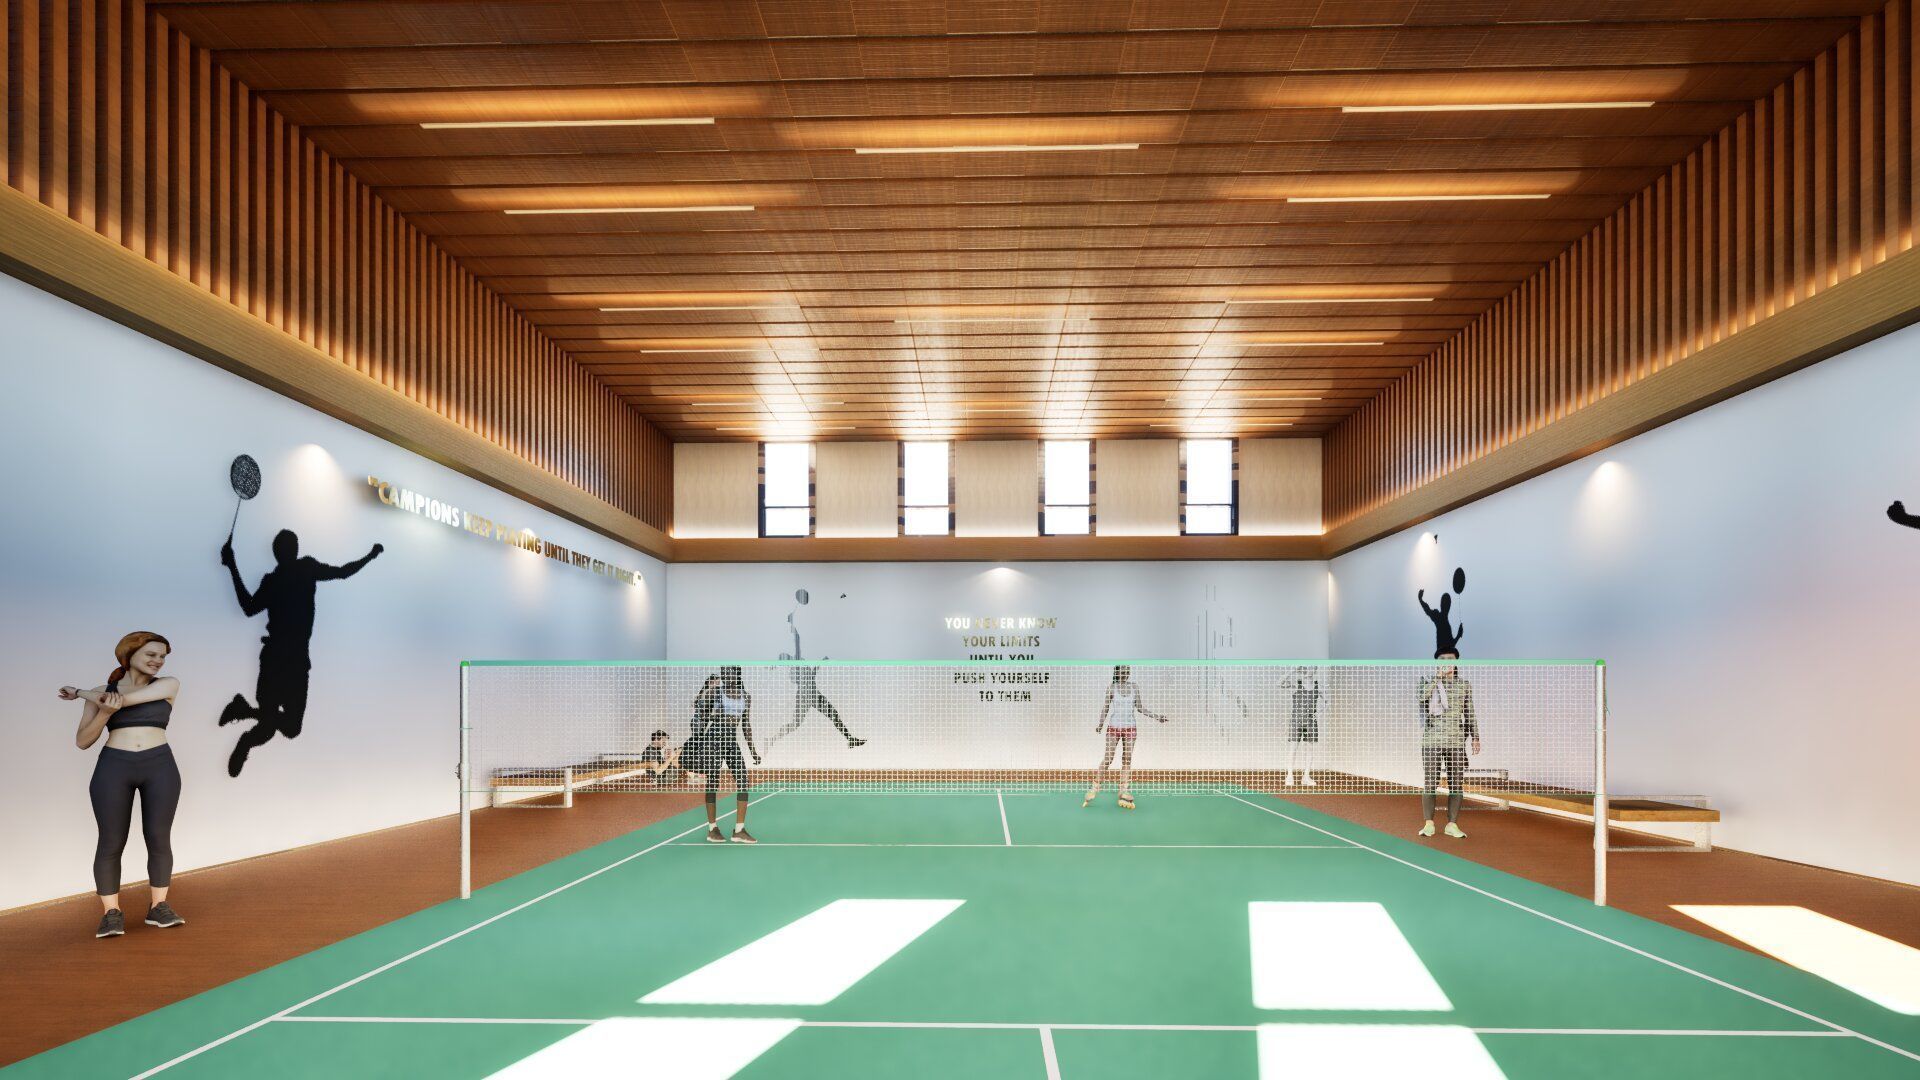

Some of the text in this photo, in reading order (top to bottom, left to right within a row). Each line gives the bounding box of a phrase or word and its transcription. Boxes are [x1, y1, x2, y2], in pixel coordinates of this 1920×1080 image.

[464, 511, 492, 538] KEEP
[544, 541, 569, 564] UNTIL
[572, 551, 590, 570] THEY
[593, 559, 605, 575] GET
[608, 564, 614, 577] IT
[945, 617, 970, 629] YOU
[1019, 617, 1057, 629] KNOW
[963, 636, 1040, 647] YOUR LIMITS
[954, 672, 1050, 683] PUSH YOURSELF
[979, 691, 1031, 701] TO THEM
